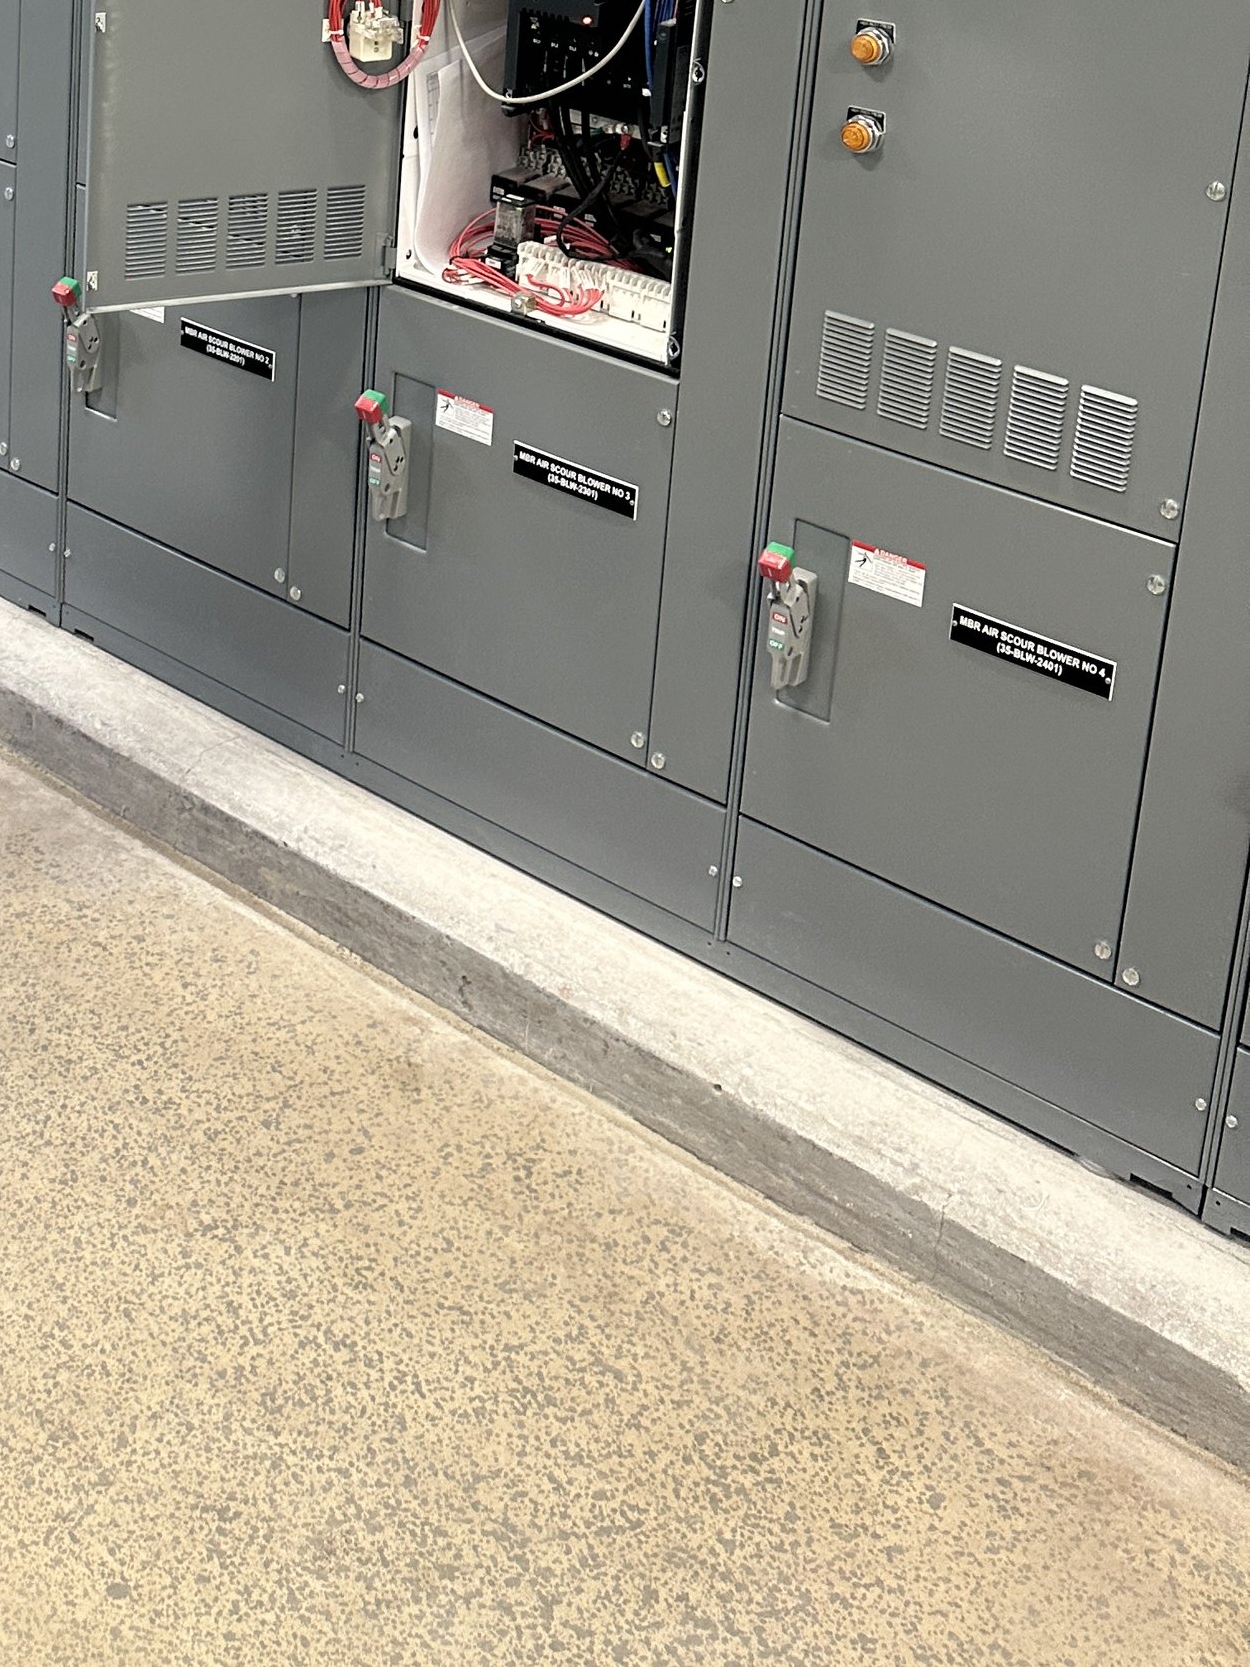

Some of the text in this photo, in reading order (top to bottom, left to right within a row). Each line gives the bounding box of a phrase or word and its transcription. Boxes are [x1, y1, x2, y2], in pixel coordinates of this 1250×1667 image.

[197, 331, 208, 342] AIR
[208, 335, 229, 349] SCOUR
[229, 342, 255, 360] BLOWER
[255, 352, 265, 363] NO
[264, 356, 270, 365] 2
[519, 450, 631, 501] MBR AIR SCOUR BLOWER NO 3
[773, 613, 786, 623] ON
[769, 639, 783, 650] OFF
[959, 615, 1106, 678] MBR AIR SCOUR BLOWER NO 4
[996, 642, 1063, 677] (35-BLW-2401)
